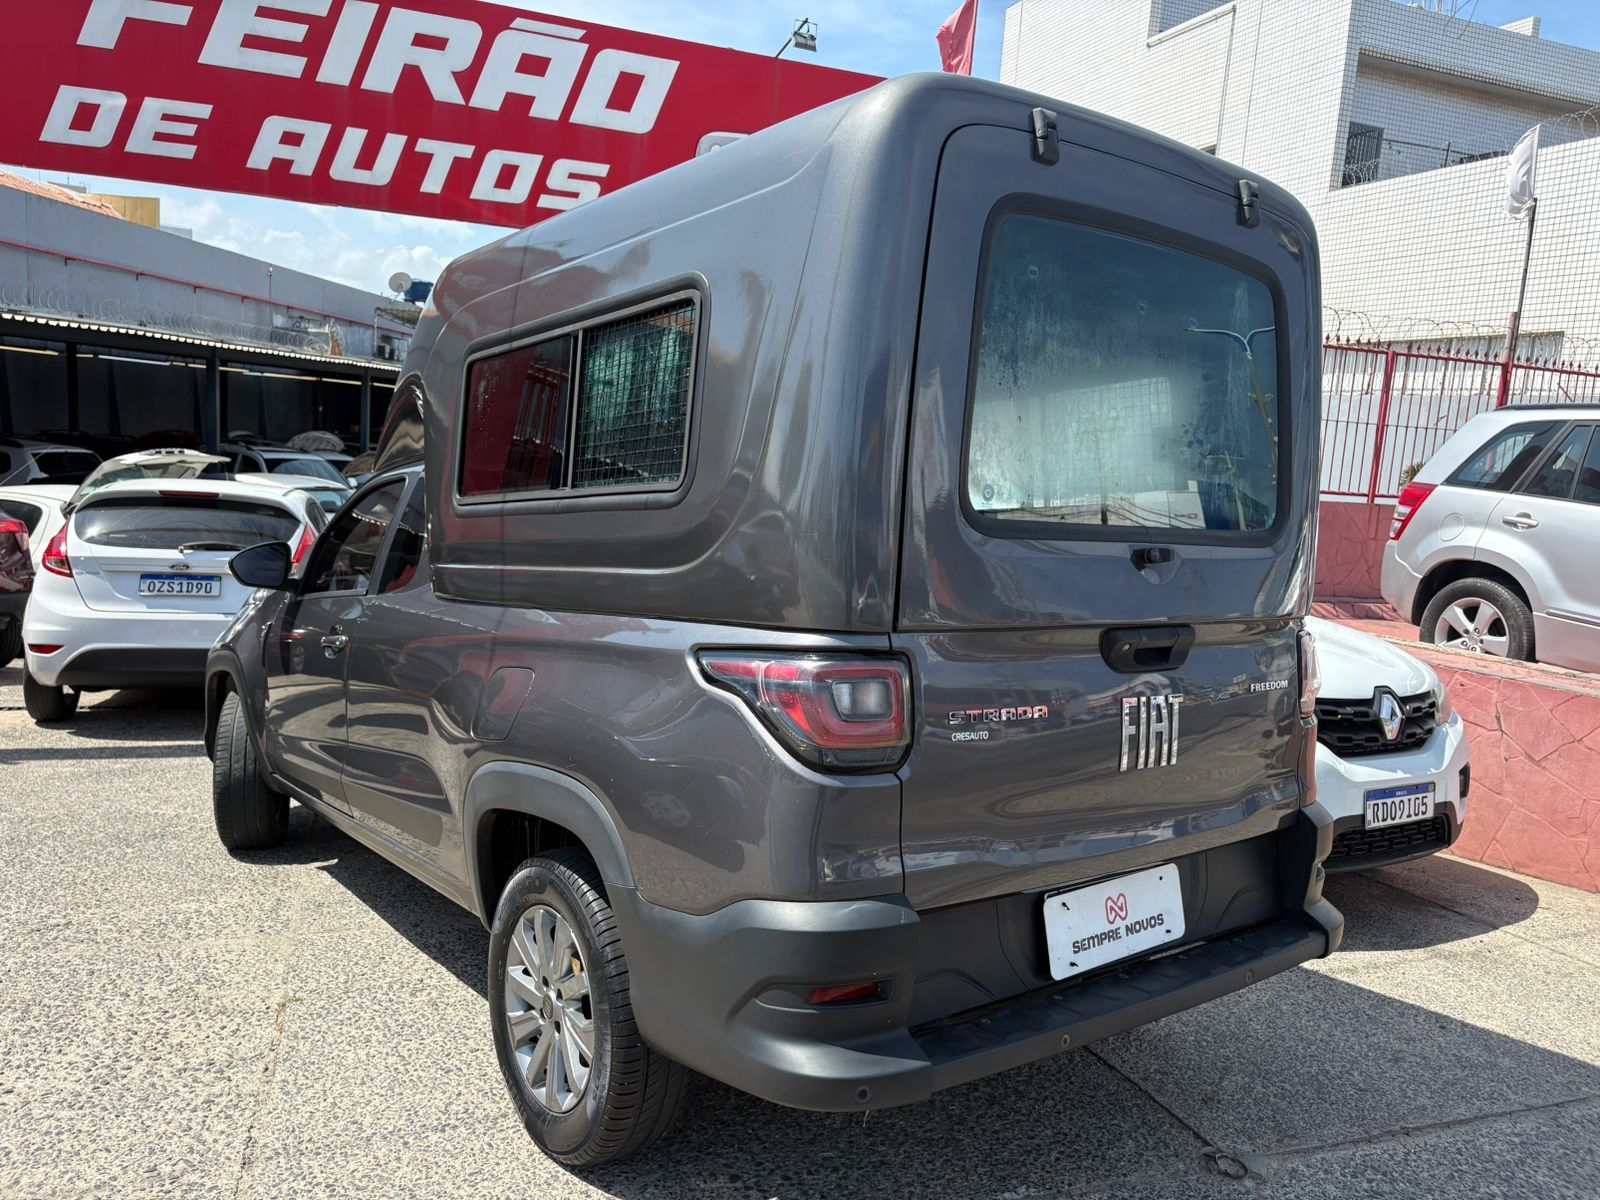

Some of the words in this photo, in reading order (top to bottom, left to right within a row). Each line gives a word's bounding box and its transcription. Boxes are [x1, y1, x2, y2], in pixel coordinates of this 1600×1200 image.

[38, 84, 214, 160] DE
[245, 115, 610, 211] AUTOS
[147, 580, 212, 594] OZS1D90
[1250, 680, 1288, 692] FREEDOM
[948, 705, 1049, 725] STRADA
[951, 731, 989, 742] CRESAUTO
[1120, 693, 1184, 772] FIAT
[1072, 926, 1122, 955] SEMPRE
[1125, 913, 1165, 937] NOVOS
